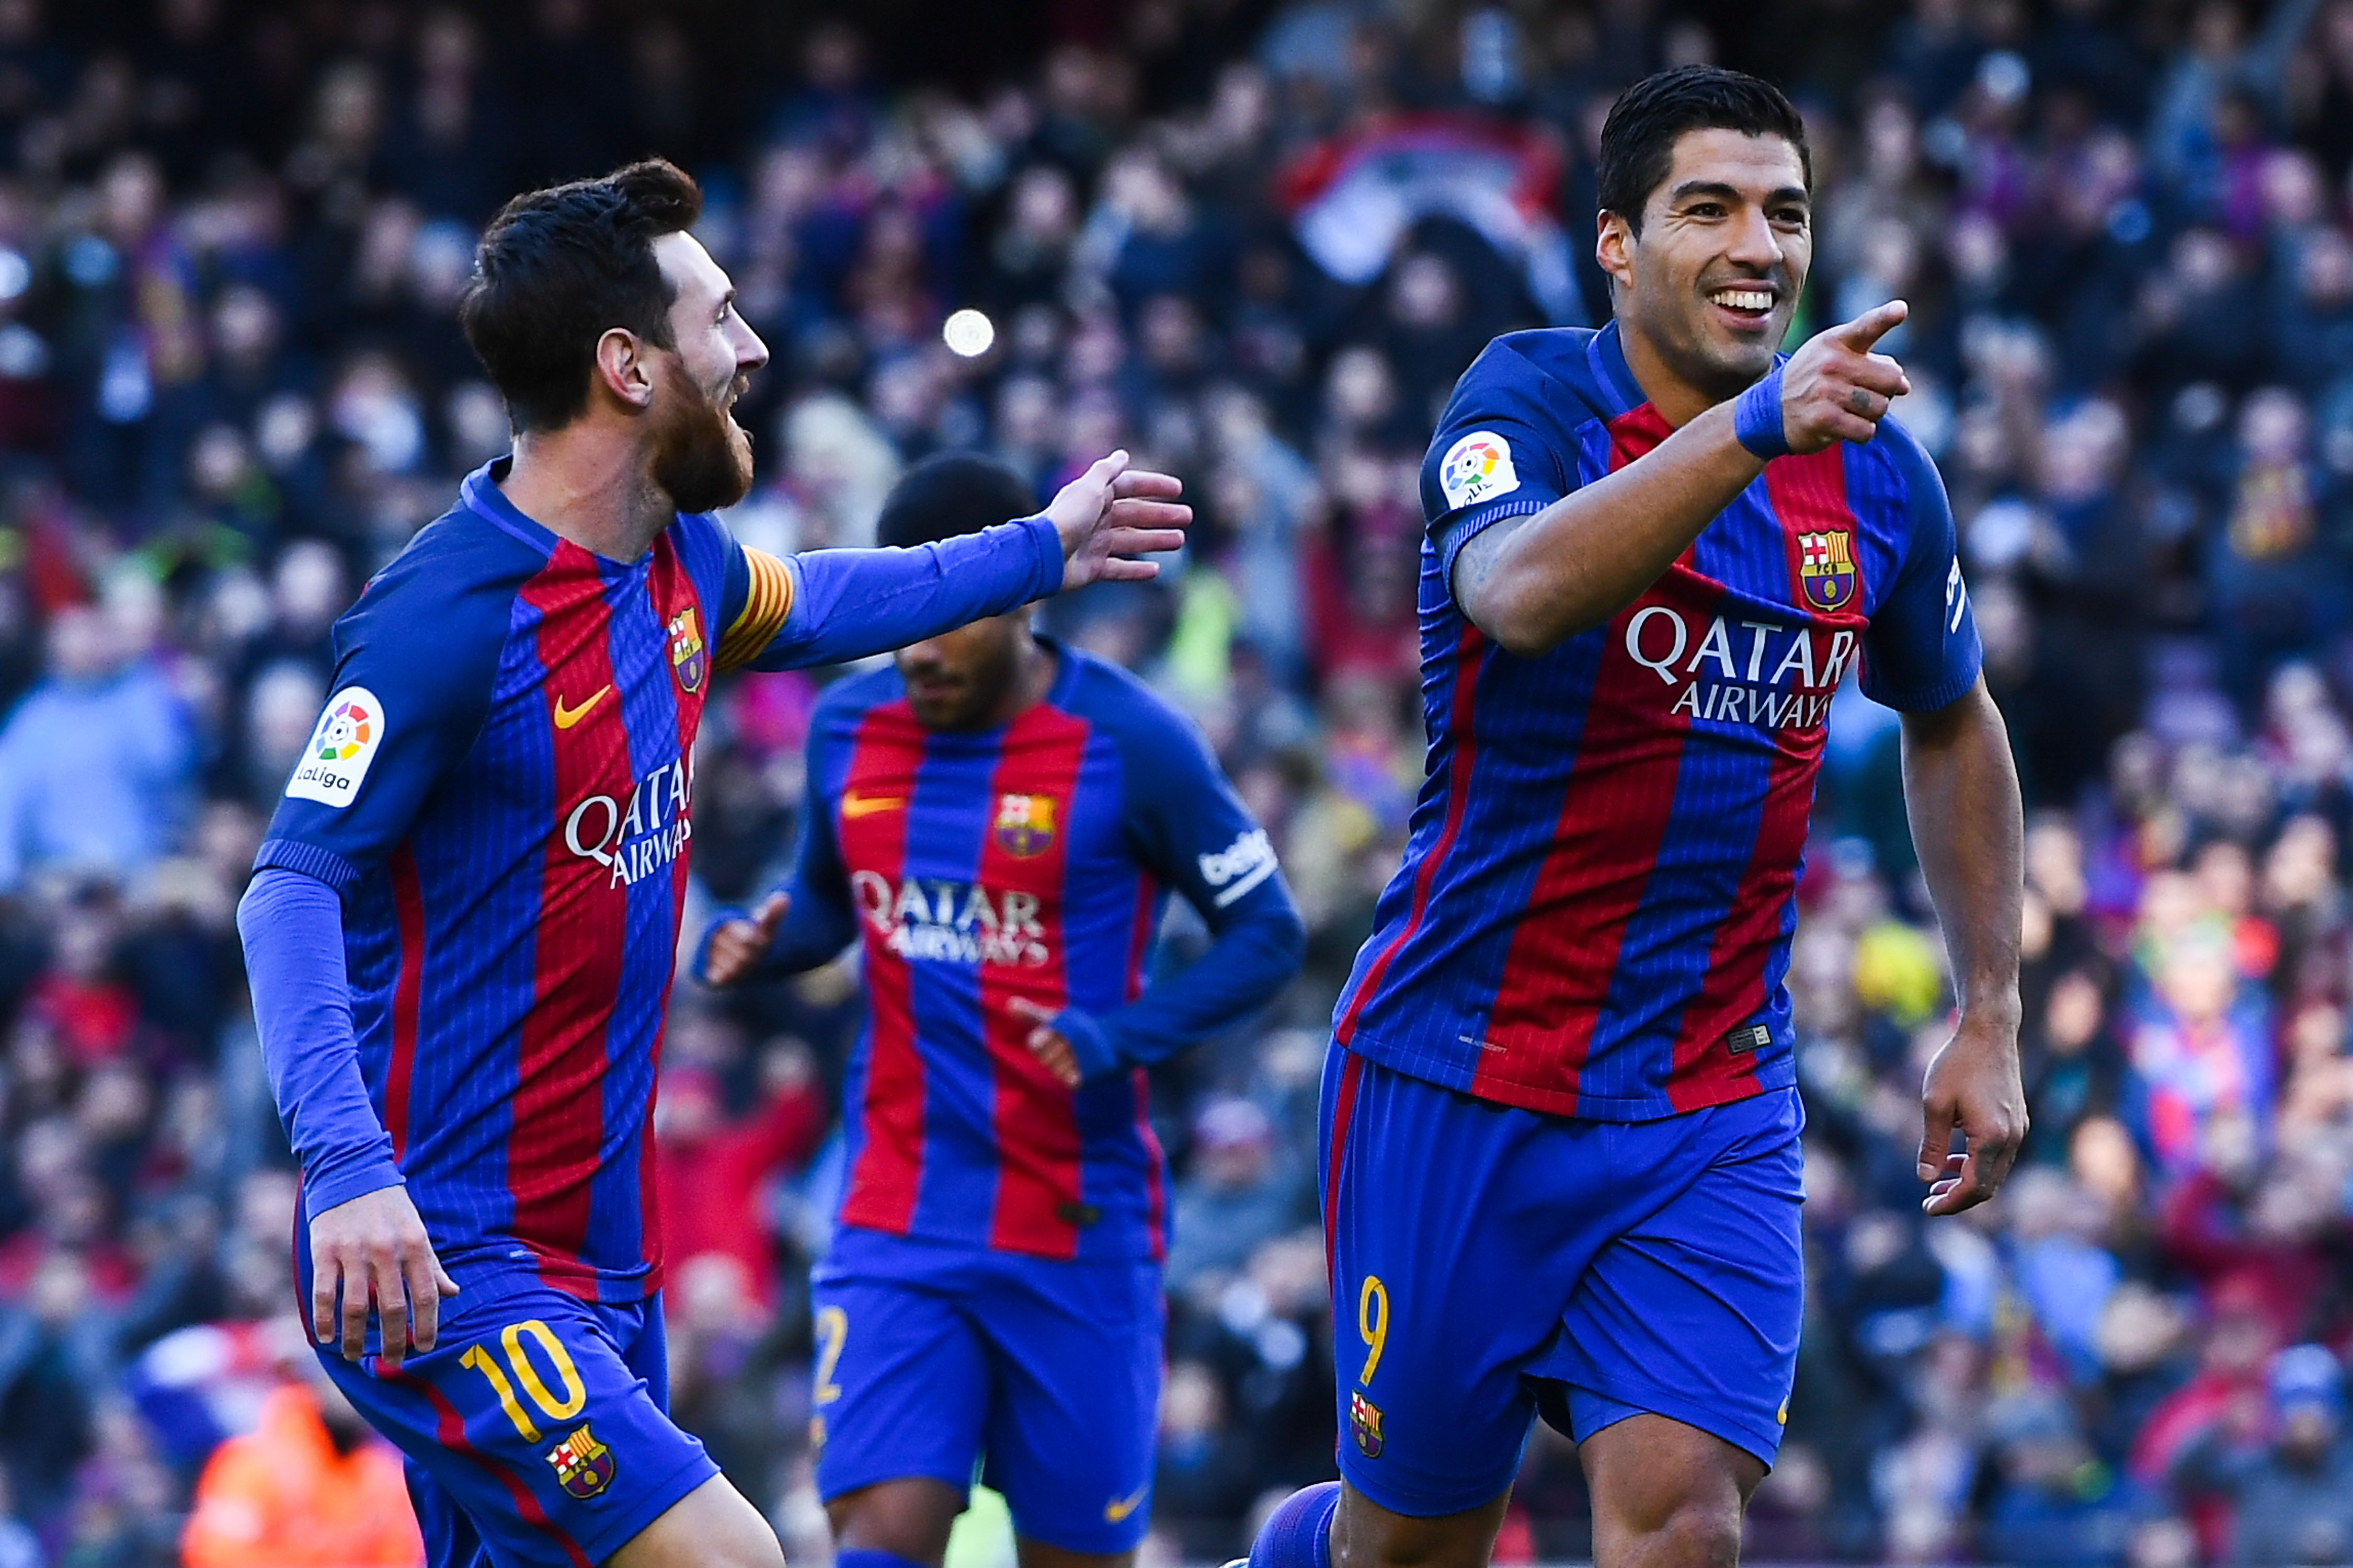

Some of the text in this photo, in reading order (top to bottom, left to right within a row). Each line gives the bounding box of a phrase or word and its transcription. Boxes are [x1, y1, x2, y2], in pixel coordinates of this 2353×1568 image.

[1625, 605, 1854, 689] QATAR
[297, 766, 350, 791] LaLiga
[851, 869, 1045, 937] QATAR
[1360, 1275, 1388, 1387] 9
[458, 1319, 586, 1443] 10
